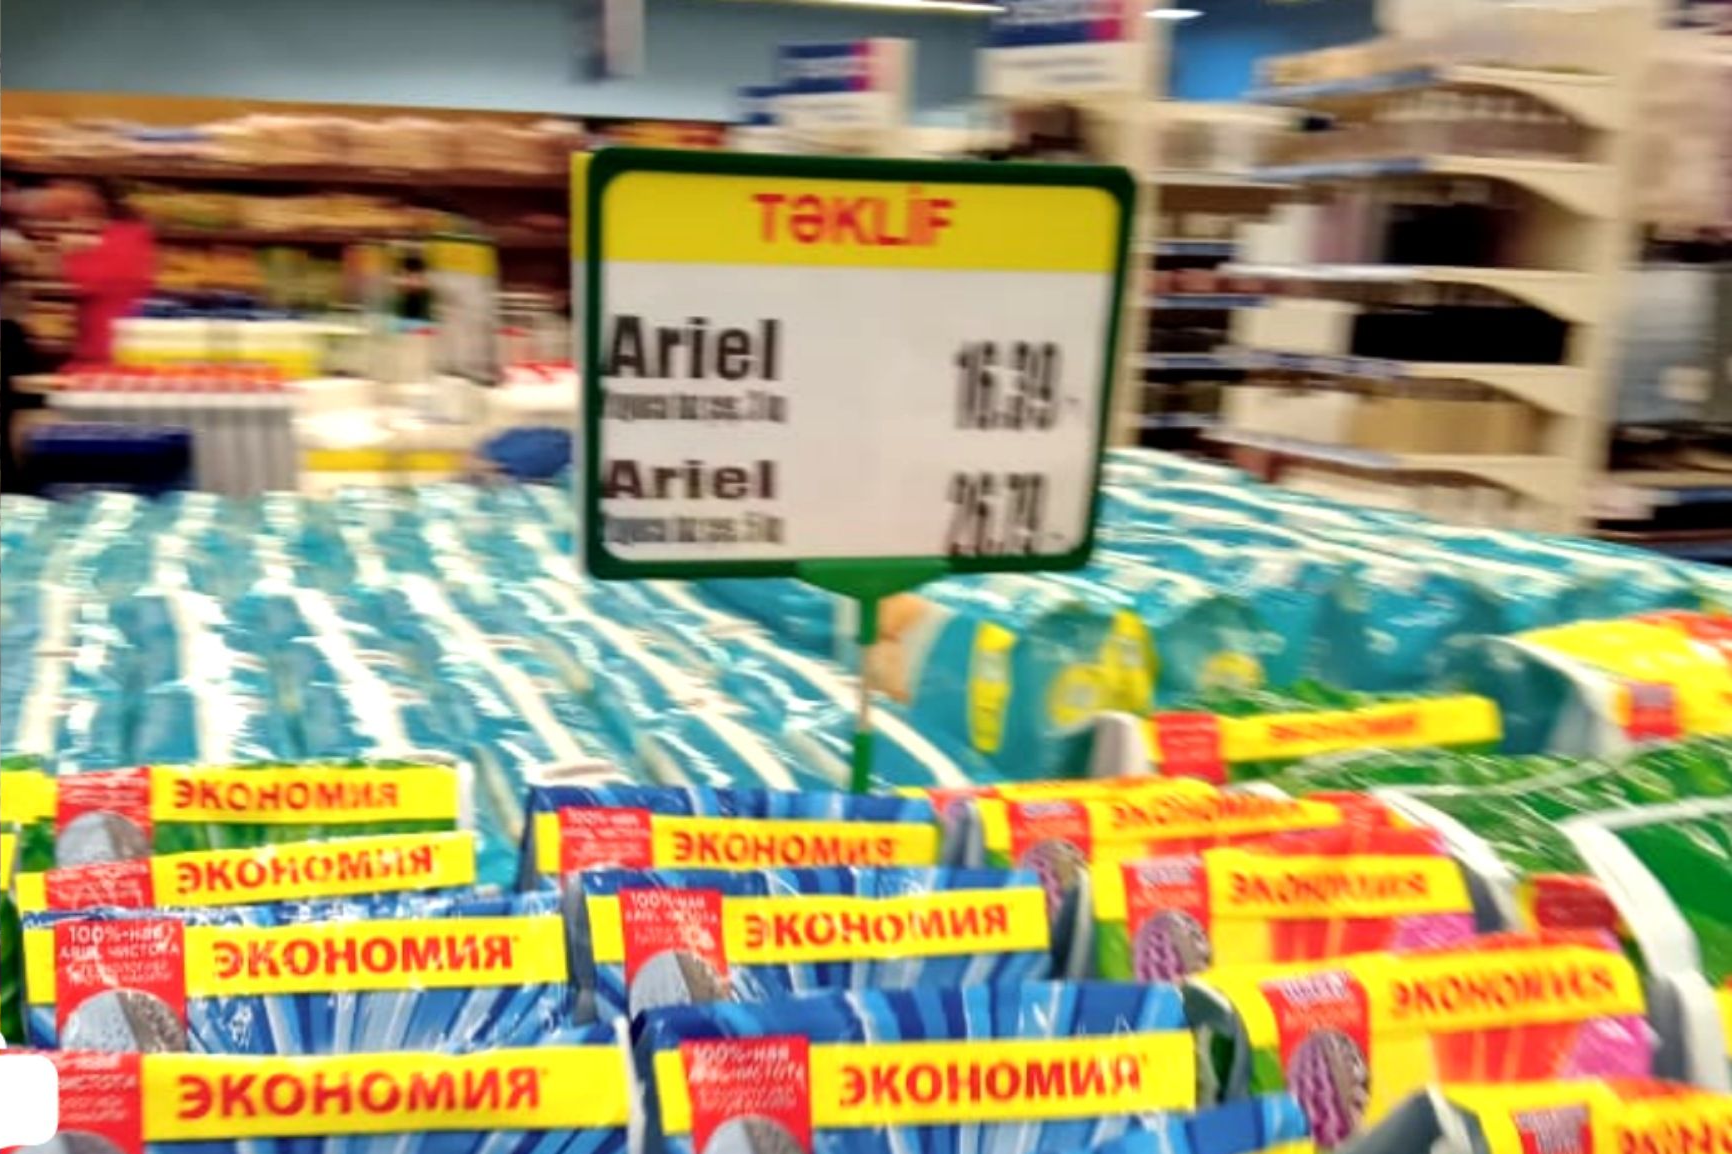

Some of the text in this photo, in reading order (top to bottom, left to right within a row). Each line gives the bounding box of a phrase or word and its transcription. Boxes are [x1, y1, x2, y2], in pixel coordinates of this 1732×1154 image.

[606, 315, 782, 381] Ariel
[602, 459, 776, 500] Ariel
[176, 1066, 550, 1122] ЭКОНОМИЯ
